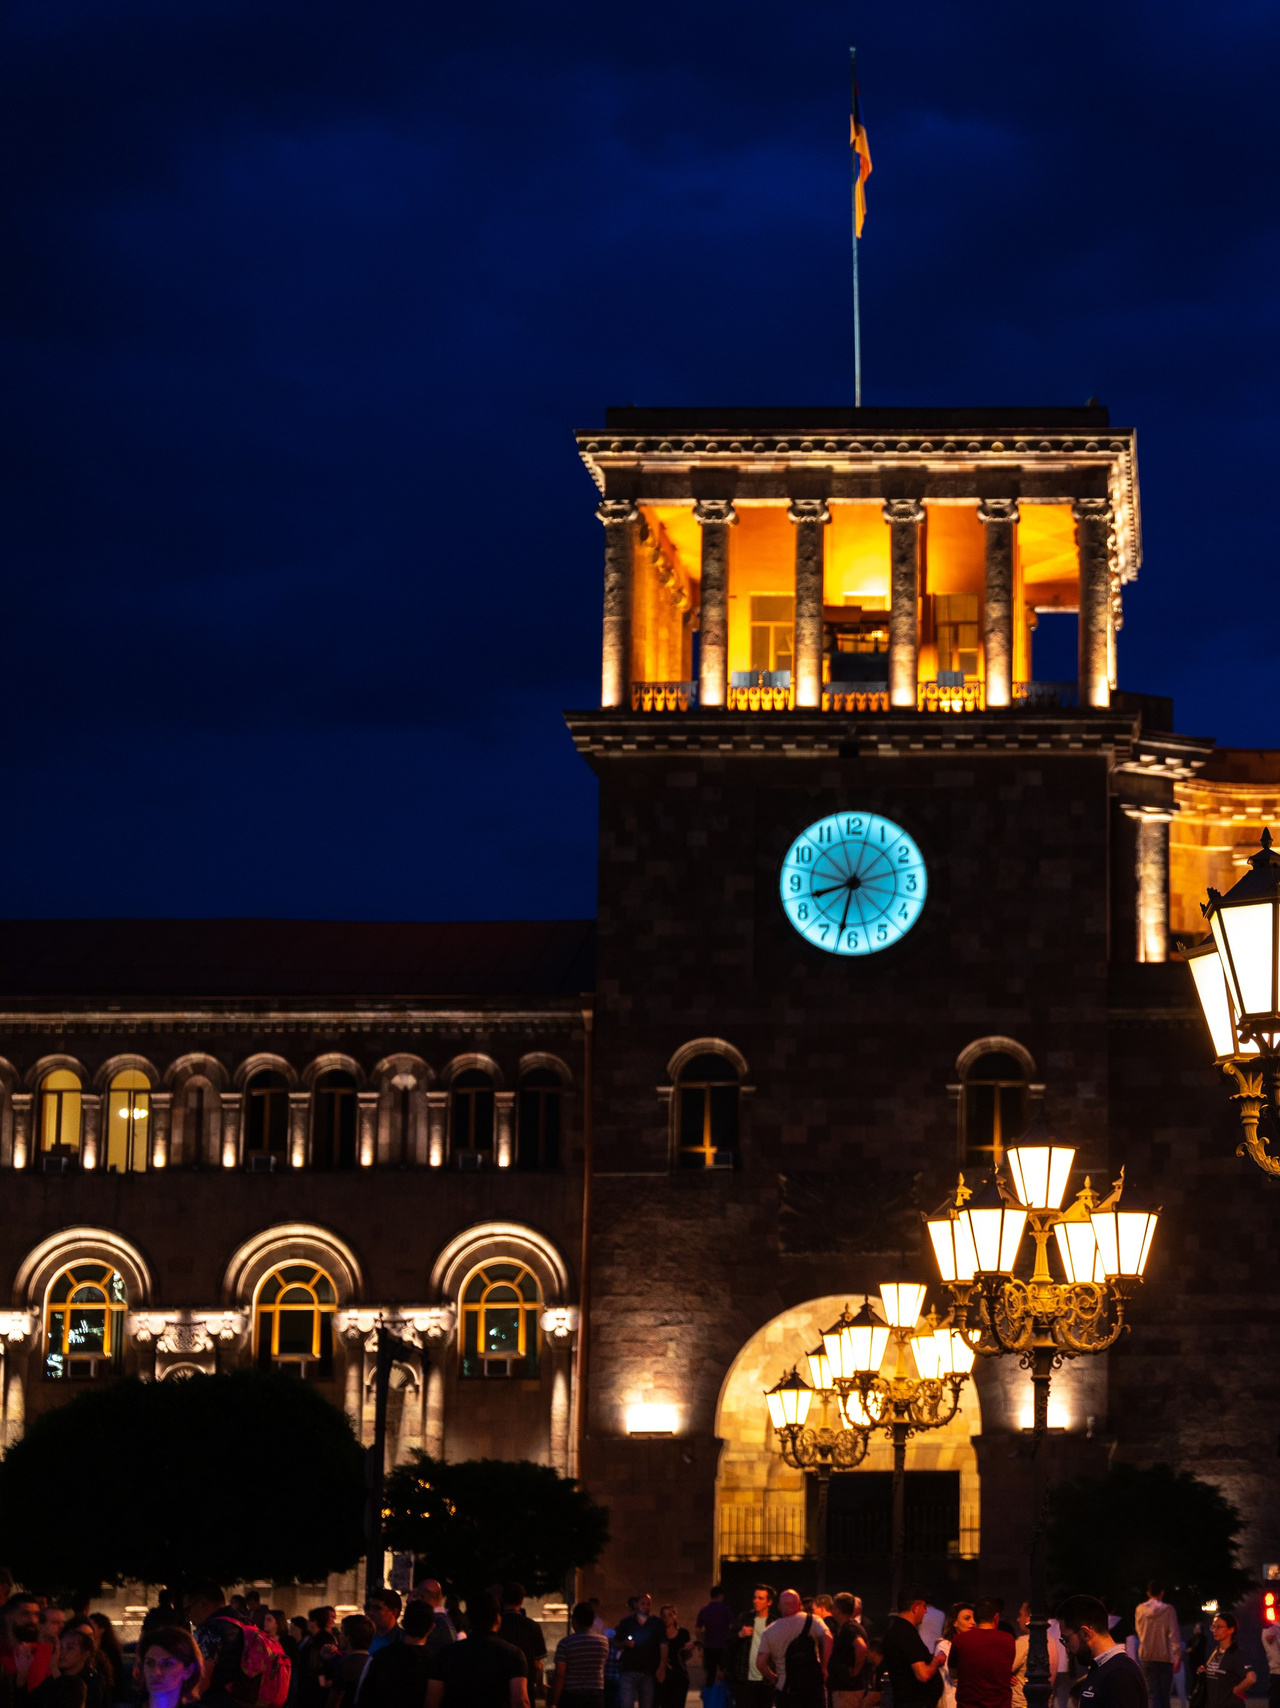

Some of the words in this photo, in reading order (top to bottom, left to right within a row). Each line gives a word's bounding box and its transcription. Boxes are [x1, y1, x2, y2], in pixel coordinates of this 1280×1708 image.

[818, 825, 832, 843] 11
[845, 817, 863, 835] 12
[879, 825, 885, 843] 1
[795, 845, 812, 864] 10
[898, 845, 910, 863] 2
[789, 873, 801, 893] 9
[905, 873, 917, 892] 3
[797, 902, 809, 920] 8
[897, 902, 909, 920] 4
[818, 923, 830, 941] 7
[847, 931, 858, 949] 6
[876, 923, 888, 942] 5
